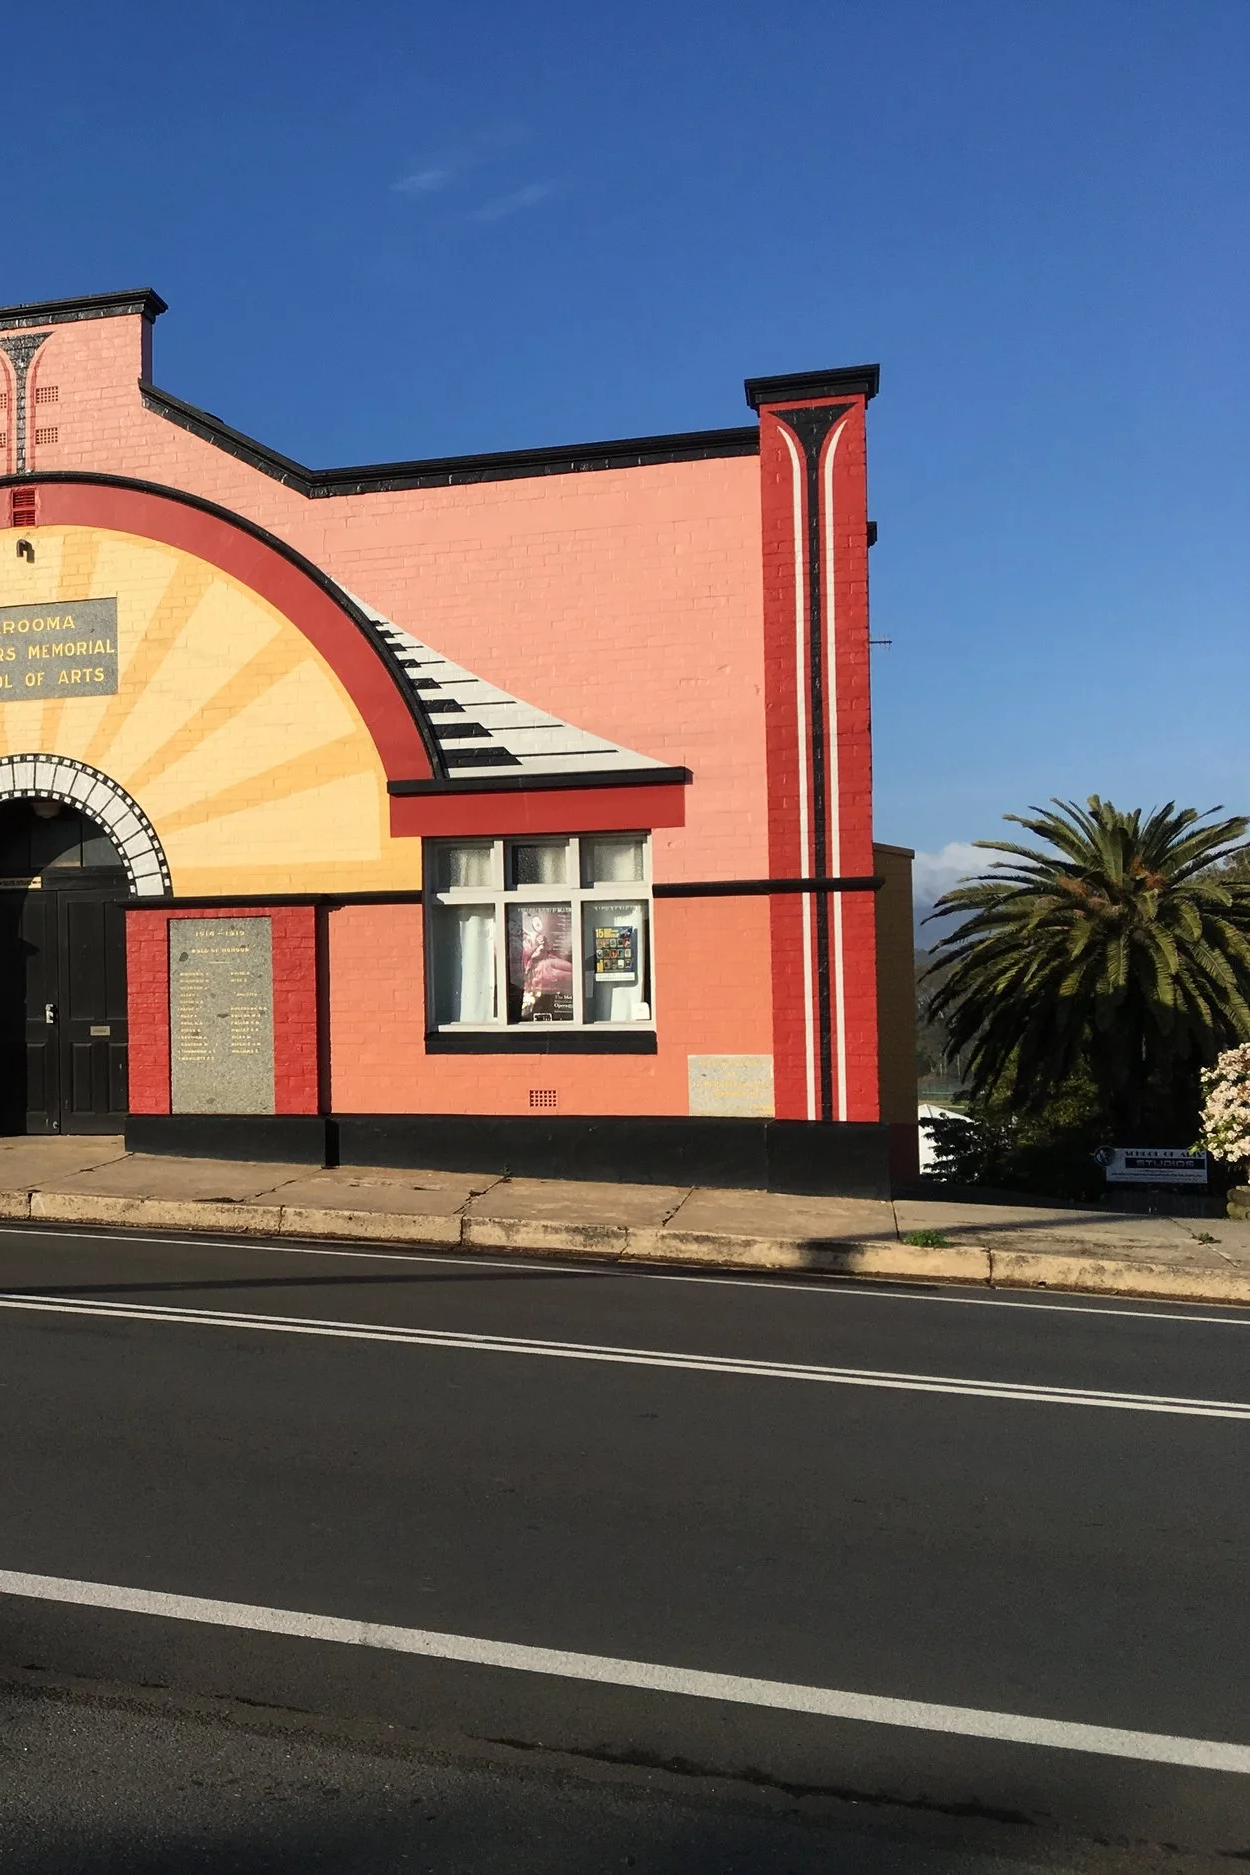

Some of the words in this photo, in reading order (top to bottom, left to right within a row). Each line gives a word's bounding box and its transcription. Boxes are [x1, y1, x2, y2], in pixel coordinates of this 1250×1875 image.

[28, 639, 115, 660] MEMORIAL
[25, 671, 45, 687] OF
[58, 667, 105, 685] ARTS
